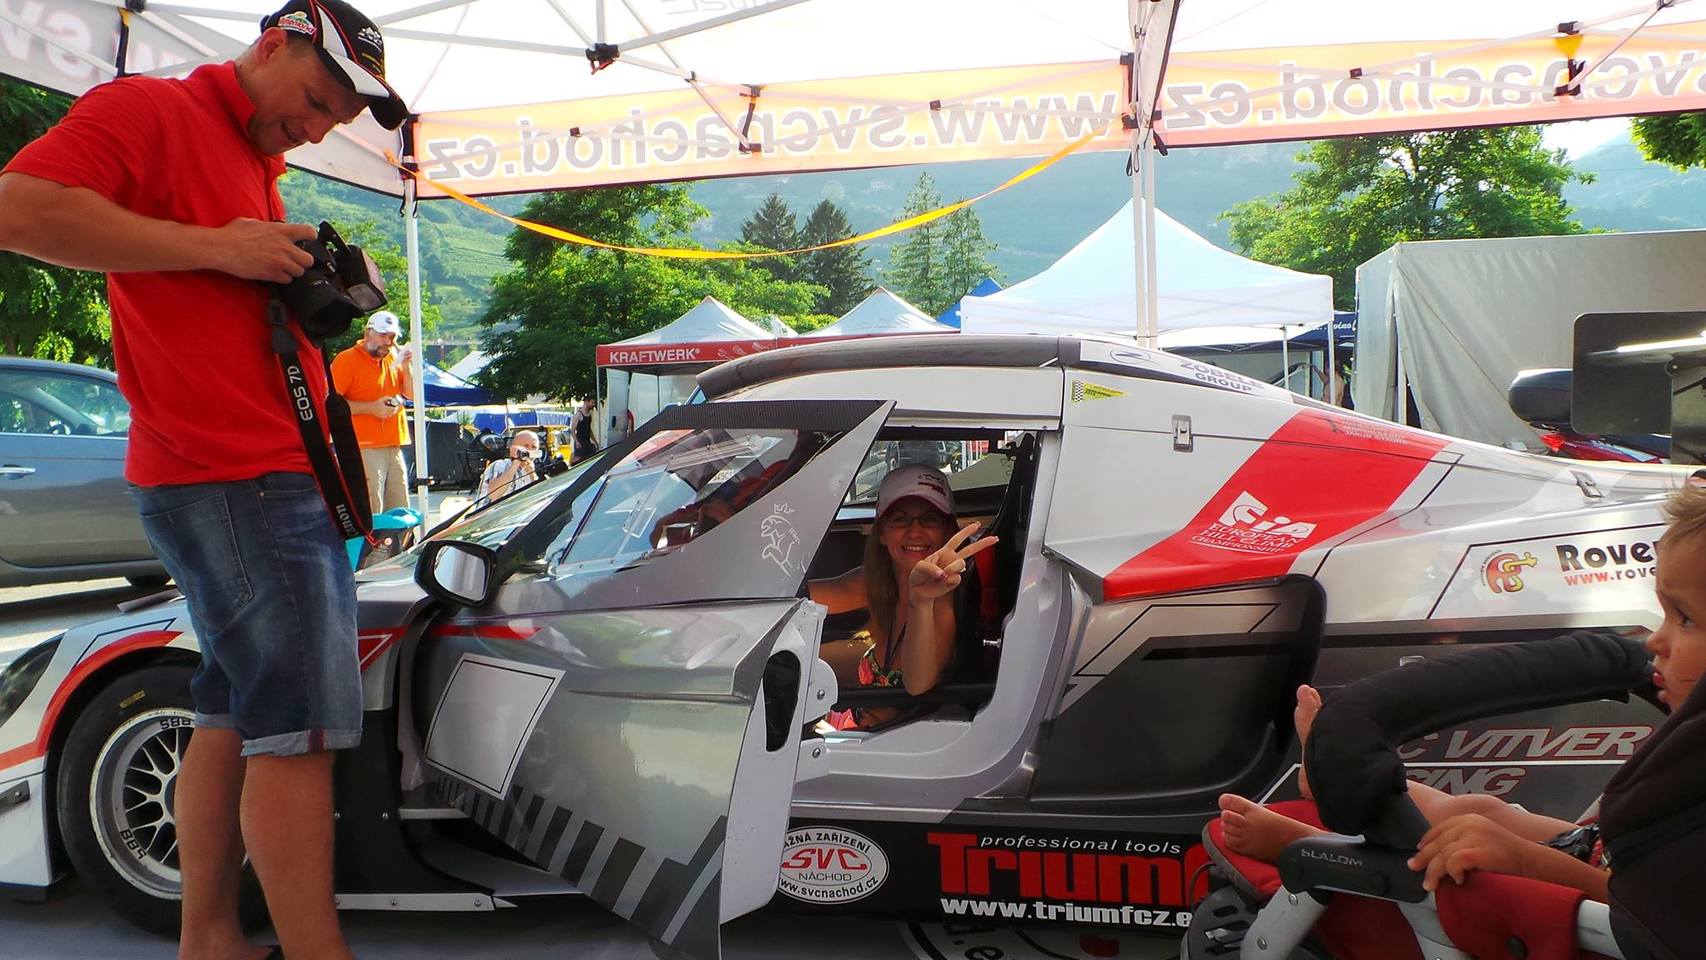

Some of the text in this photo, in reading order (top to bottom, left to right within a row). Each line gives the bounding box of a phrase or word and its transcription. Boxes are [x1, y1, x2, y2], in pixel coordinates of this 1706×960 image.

[1195, 372, 1252, 391] GROUP
[287, 365, 314, 421] EOS 7D
[1200, 530, 1294, 549] HILL CLIMB
[1208, 522, 1304, 544] EUROPEAN
[1191, 535, 1285, 553] CHAMPIONSHIP
[1443, 726, 1654, 759] VITVER
[120, 829, 147, 860] BBS
[981, 834, 1181, 855] professional tools
[781, 848, 868, 870] SVC
[798, 871, 852, 882] NÁCHOD
